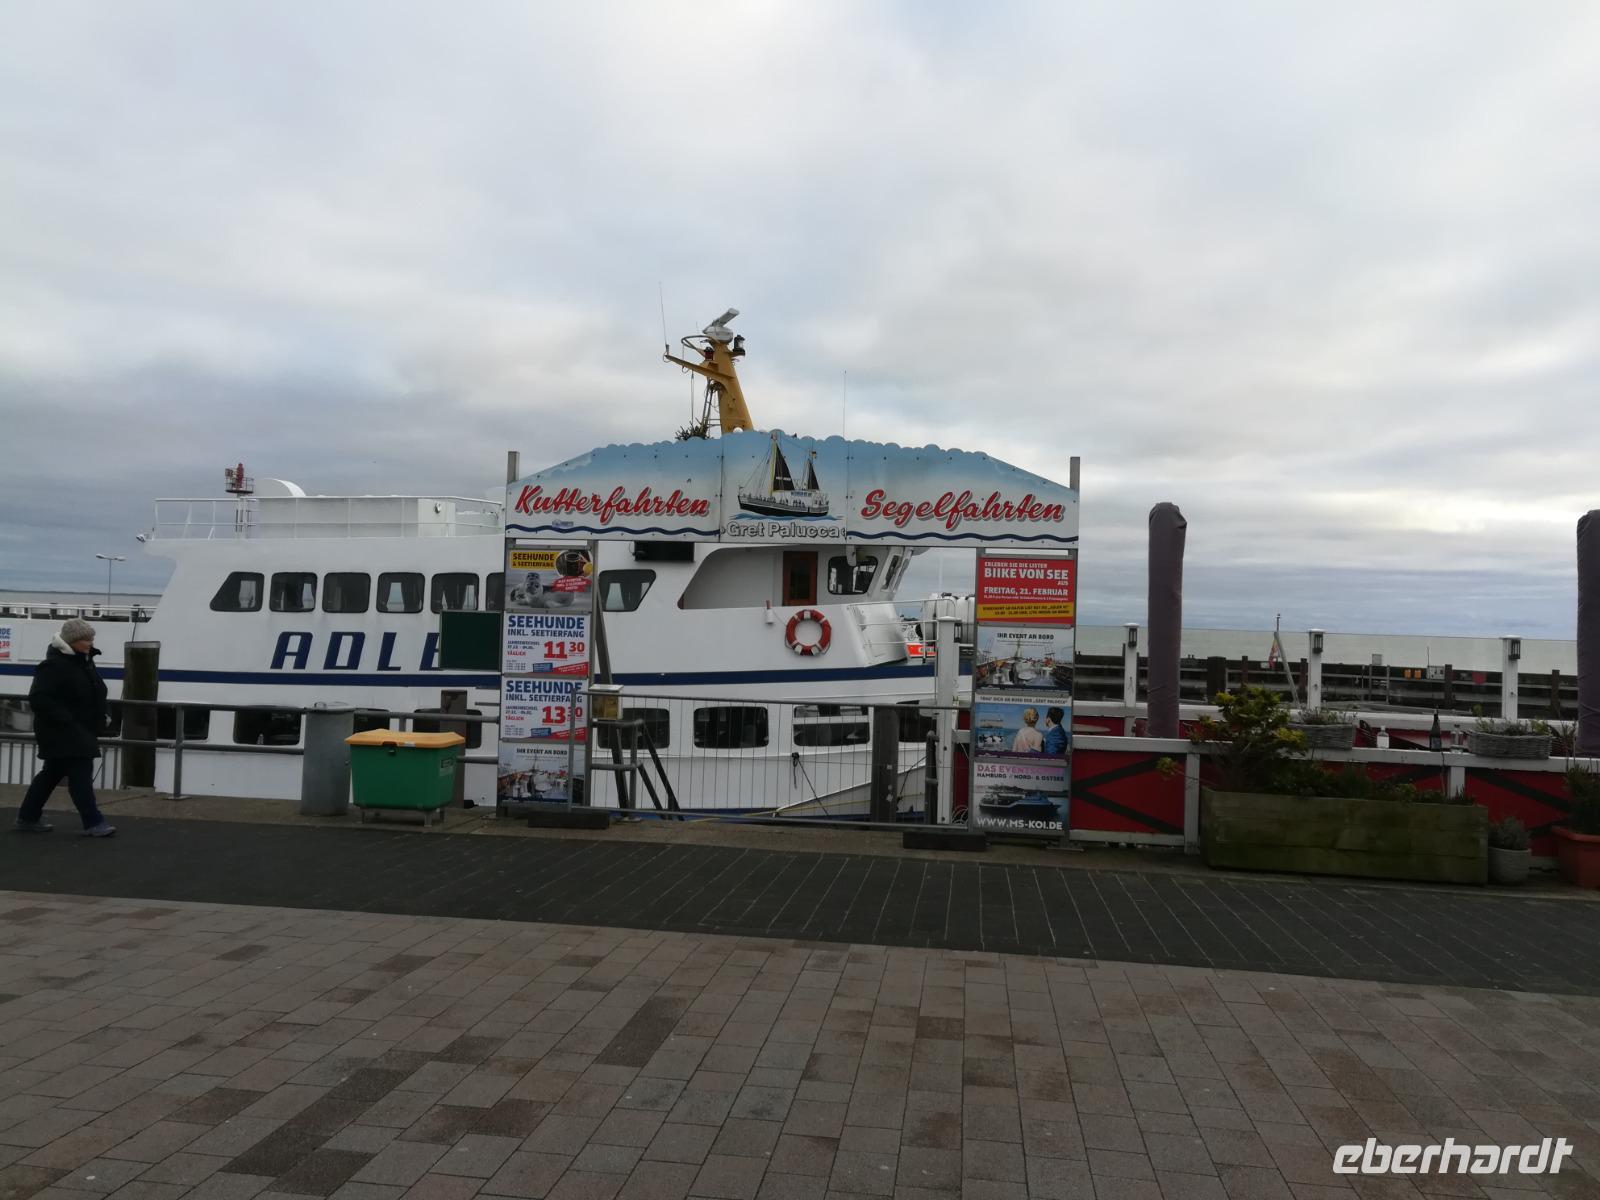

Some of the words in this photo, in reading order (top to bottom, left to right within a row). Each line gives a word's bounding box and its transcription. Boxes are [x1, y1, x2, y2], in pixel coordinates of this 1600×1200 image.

[515, 485, 709, 525] Kutterfahrten
[860, 489, 1066, 532] Segelfahrten
[727, 521, 765, 538] Gret
[767, 522, 840, 539] Palucca
[512, 552, 555, 561] SEEHUNDE
[984, 567, 1017, 578] BIIKE
[1019, 568, 1045, 579] VON
[1046, 569, 1069, 580] SEE
[983, 586, 1018, 596] FREITAG,
[1033, 588, 1069, 597] FEBRUAR
[508, 615, 585, 630] SEEHUNDE
[507, 628, 529, 637] INKL.
[531, 629, 585, 638] SEETIERFANG
[543, 640, 568, 659] 11
[568, 641, 585, 653] 30
[506, 680, 583, 694] SEEHUNDE
[506, 693, 527, 702] INKL.
[541, 705, 566, 724] 13
[977, 764, 997, 773] DAS
[977, 818, 1063, 830] WWW.MS-KOI.DE
